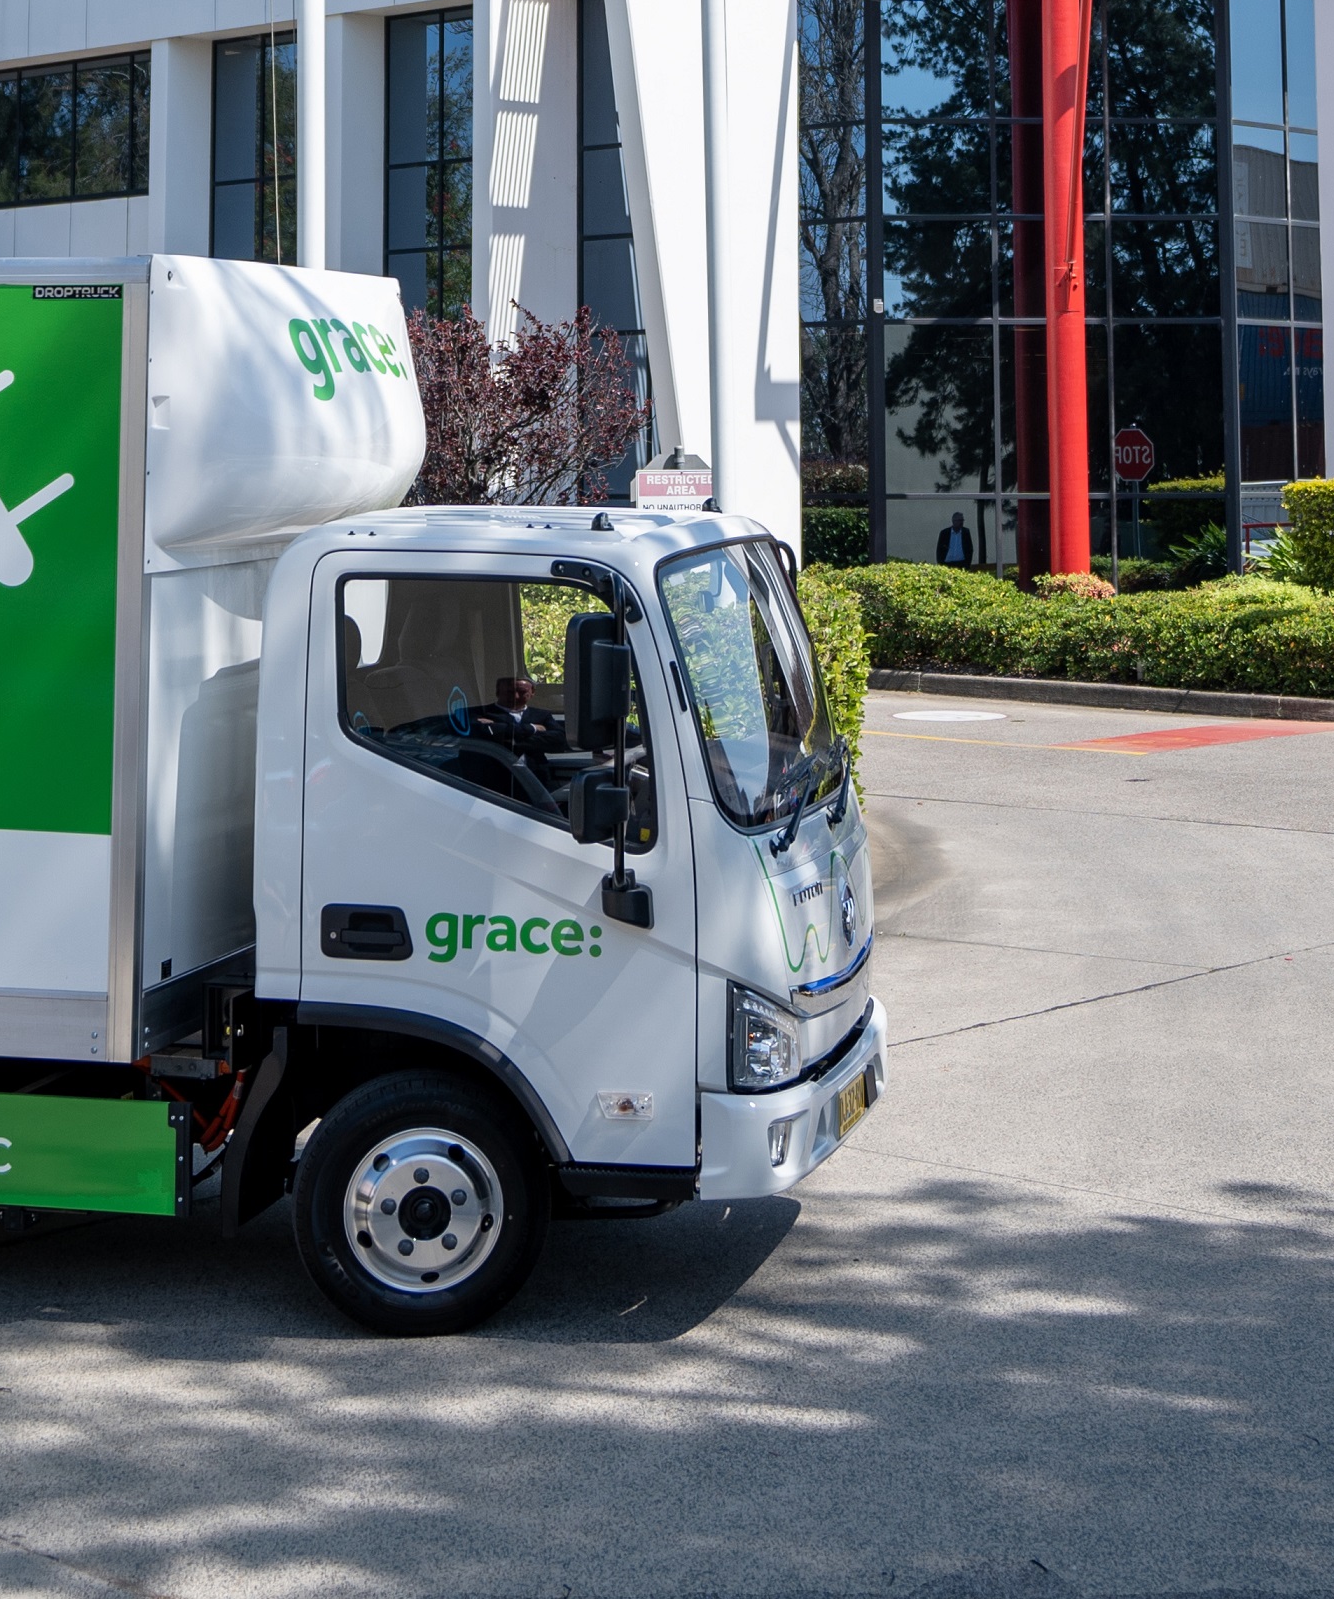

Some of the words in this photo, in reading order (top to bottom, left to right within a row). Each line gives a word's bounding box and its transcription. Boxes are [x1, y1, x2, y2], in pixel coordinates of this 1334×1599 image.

[35, 287, 120, 298] DROPTRUCK
[288, 318, 408, 401] grace:
[667, 486, 696, 495] AREA
[425, 912, 603, 963] grace:
